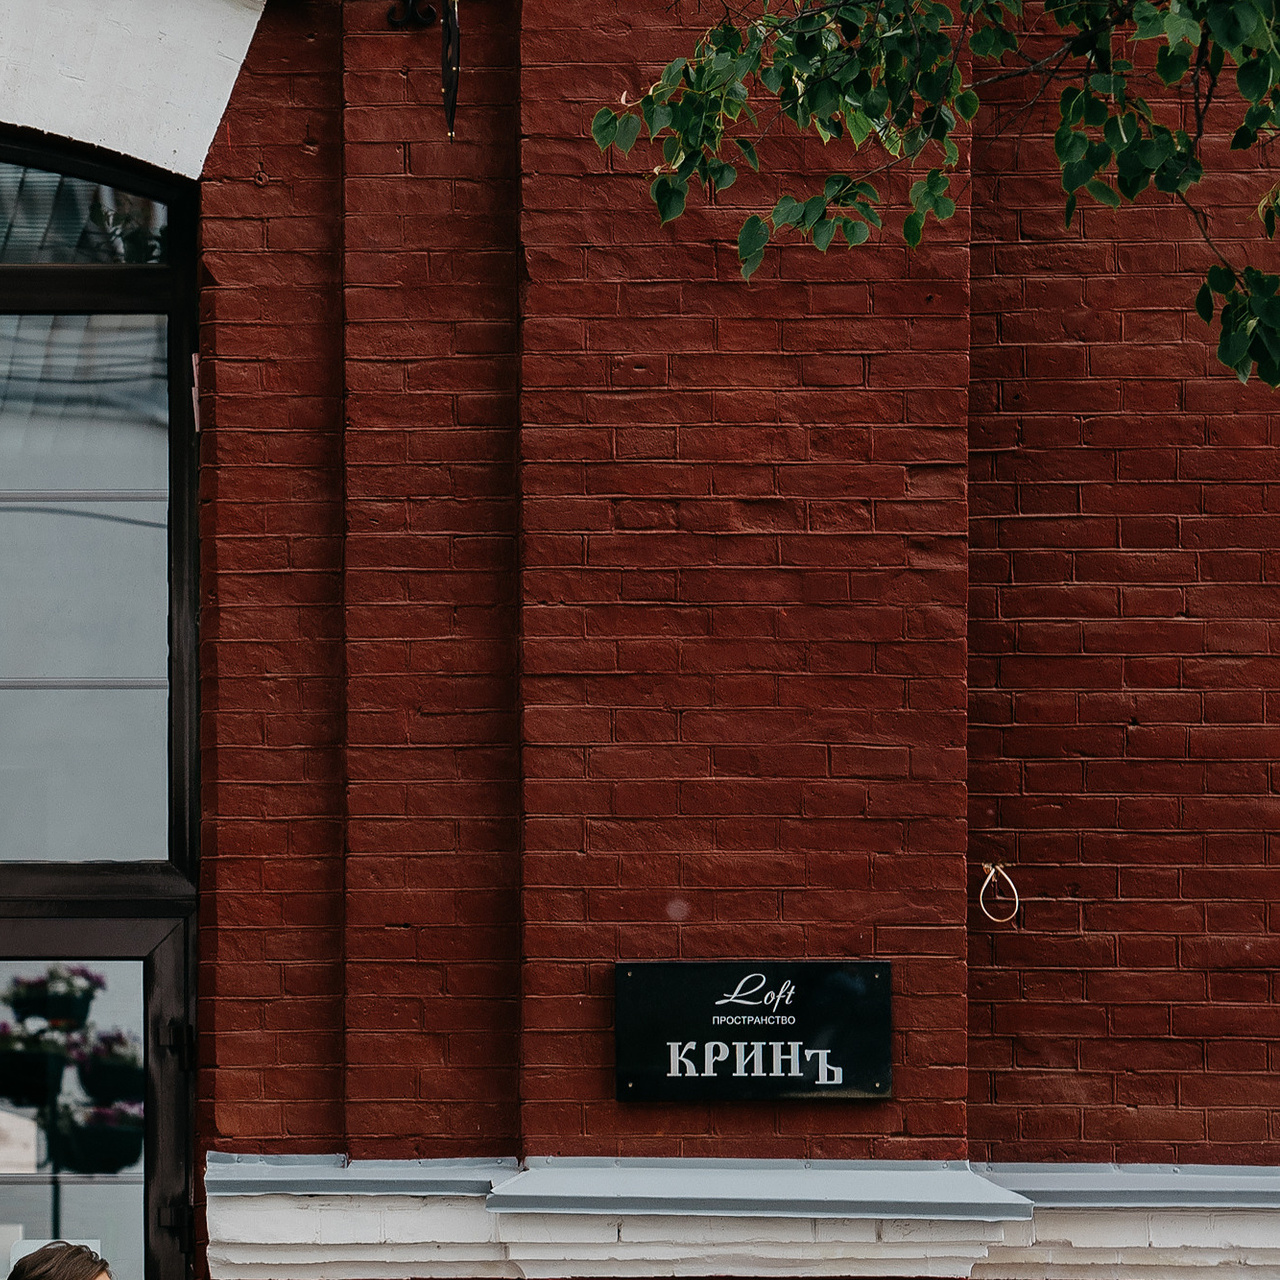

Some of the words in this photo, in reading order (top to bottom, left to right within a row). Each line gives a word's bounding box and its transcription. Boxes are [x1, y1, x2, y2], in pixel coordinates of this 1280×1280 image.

[714, 973, 796, 1013] Loft
[712, 1015, 796, 1026] ПРОСТРАНСТВО
[666, 1041, 843, 1085] КРИНЪ
